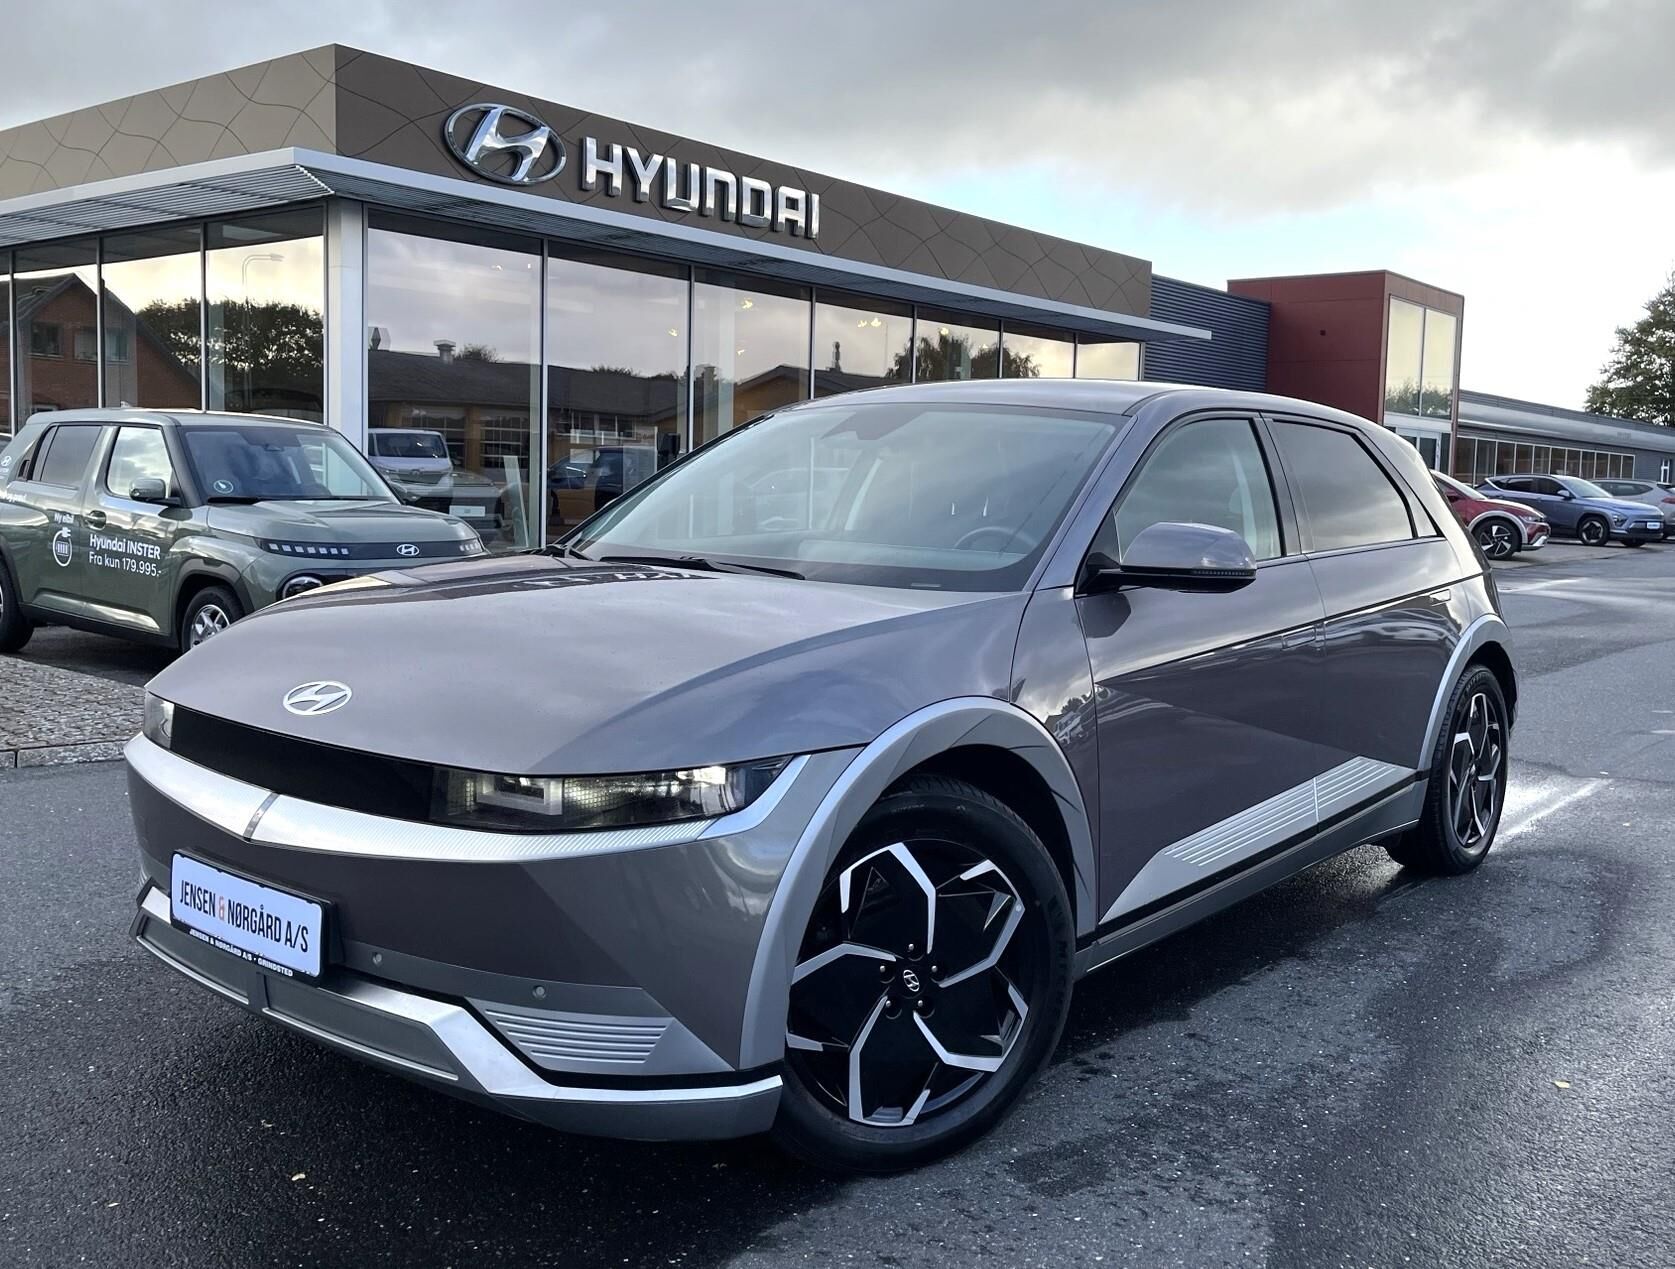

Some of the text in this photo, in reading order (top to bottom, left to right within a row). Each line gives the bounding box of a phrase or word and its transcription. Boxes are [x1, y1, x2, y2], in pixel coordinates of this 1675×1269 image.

[582, 136, 820, 239] HYUNDAI
[89, 533, 161, 560] Hyundai INSTER
[89, 551, 103, 566] Fra
[104, 553, 120, 569] kun
[180, 880, 309, 953] JENSEN & NØRGÅRD A/S
[257, 957, 293, 977] GRINDSTED
